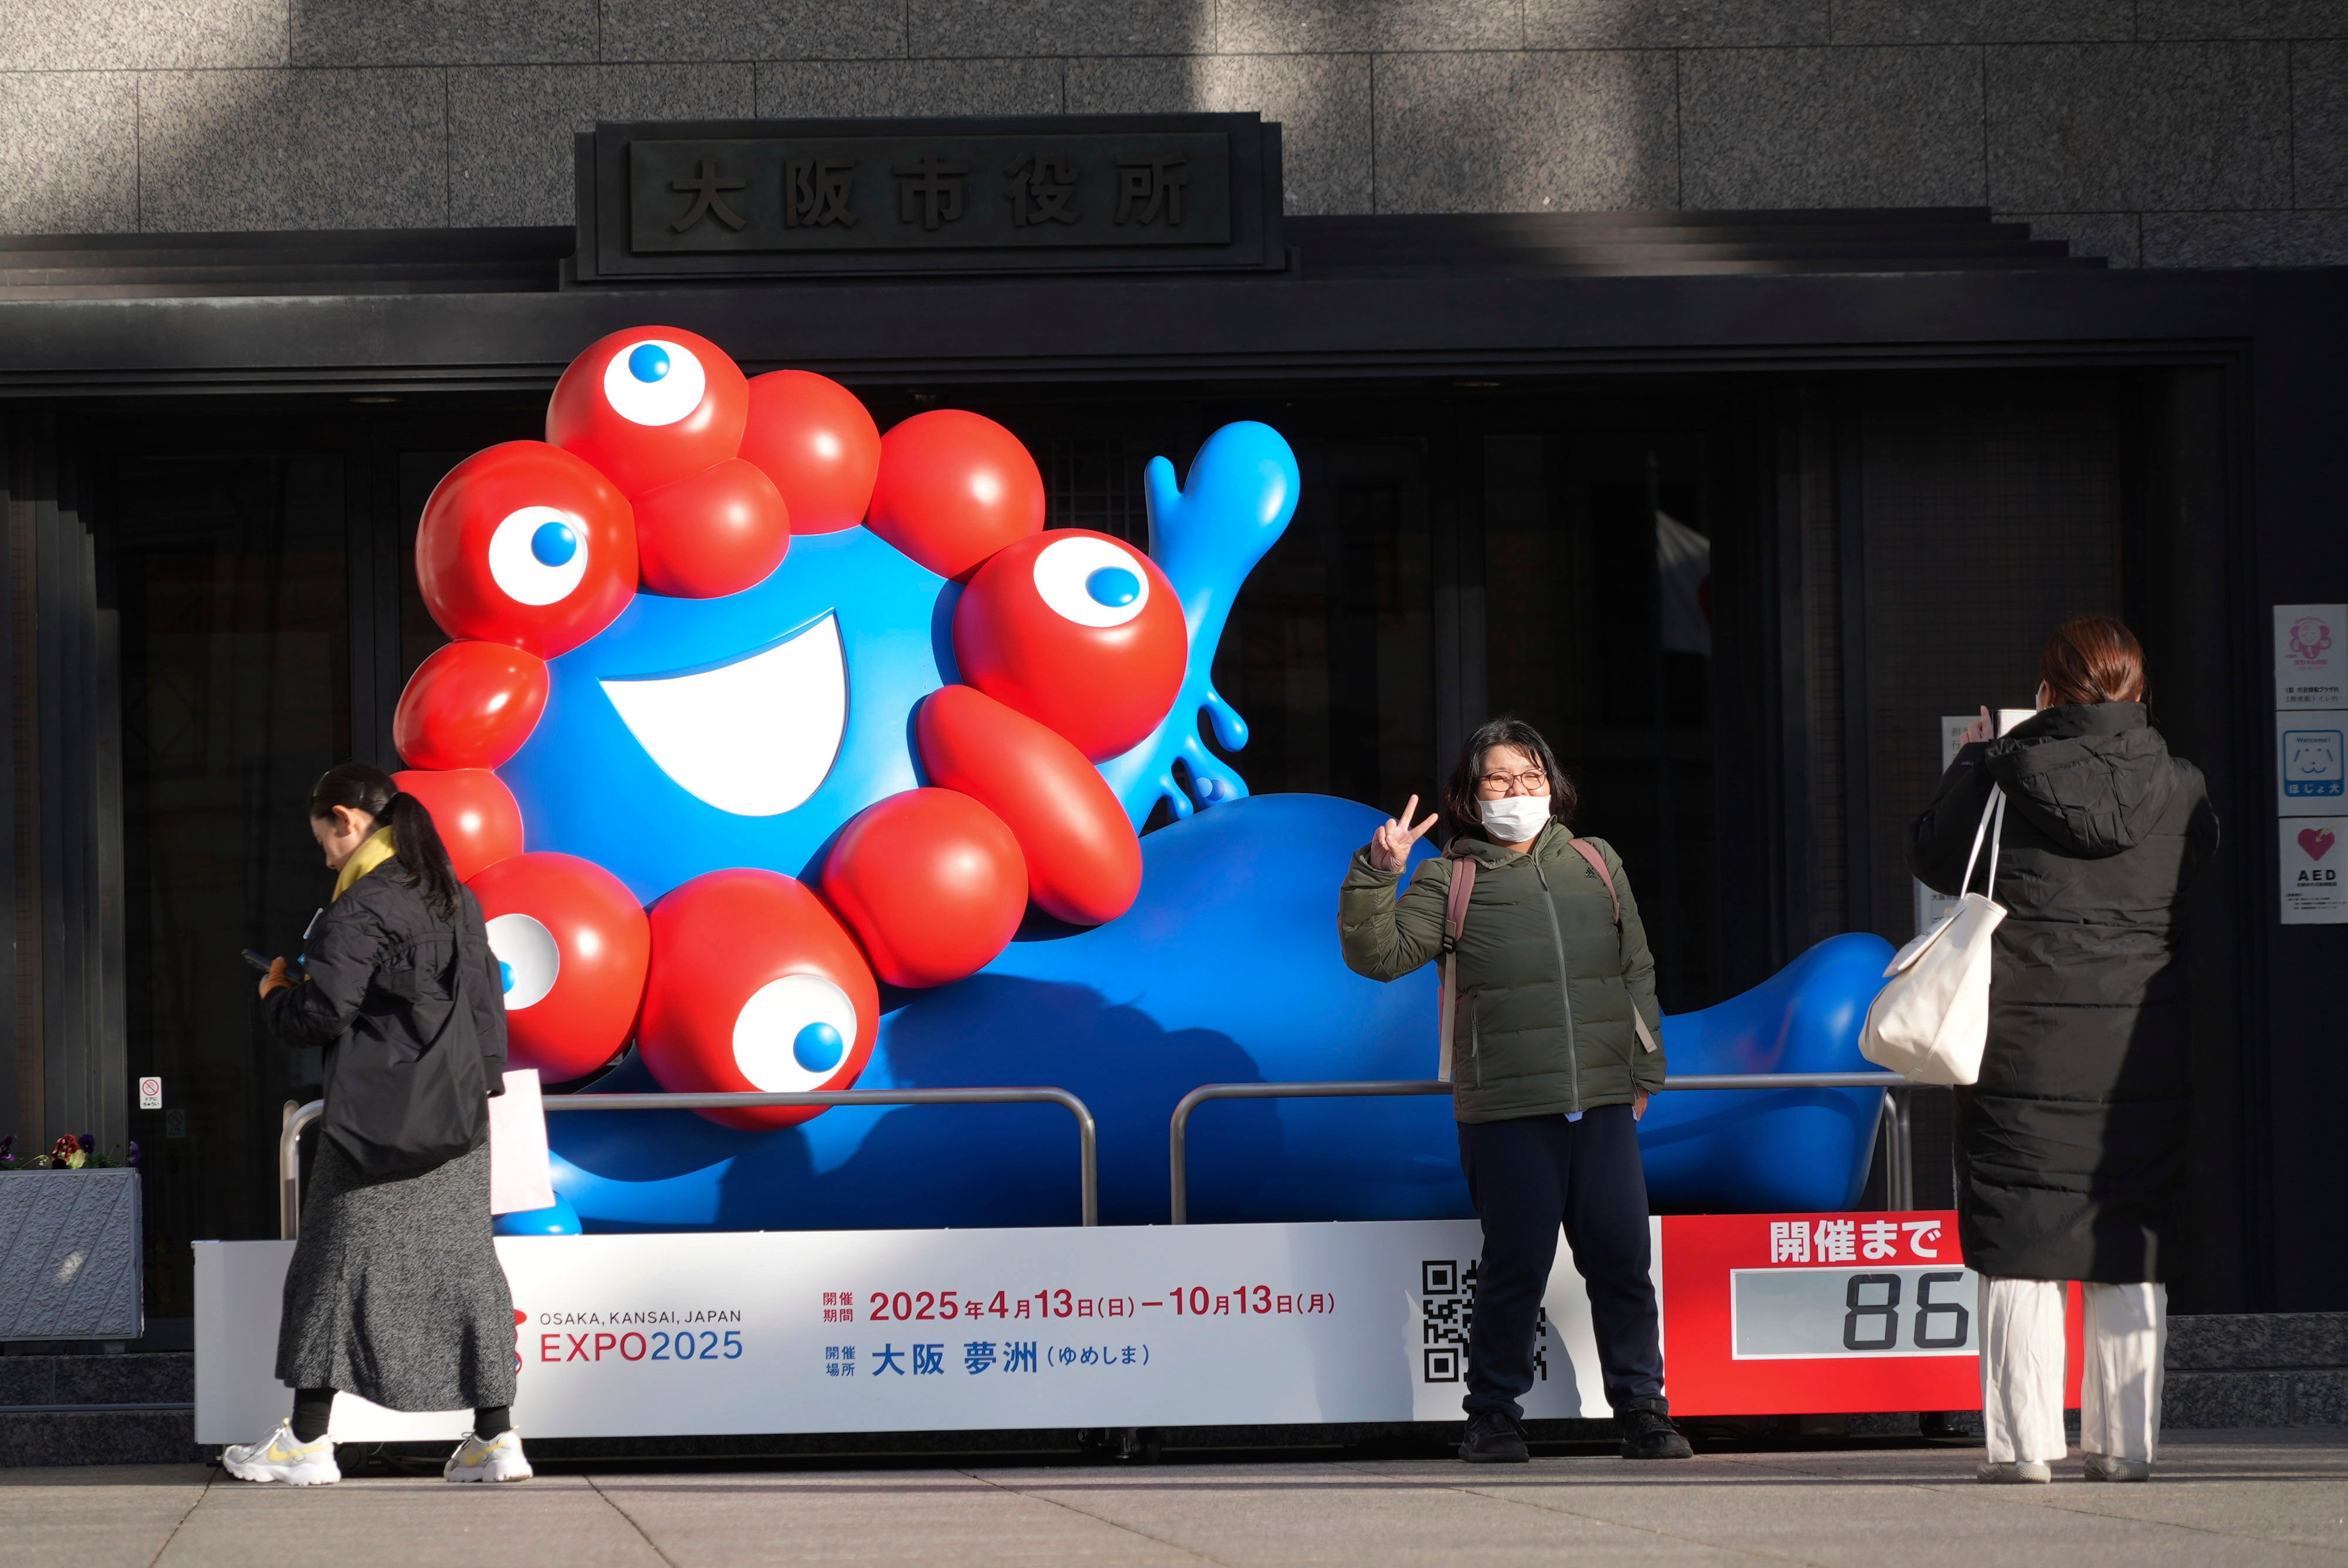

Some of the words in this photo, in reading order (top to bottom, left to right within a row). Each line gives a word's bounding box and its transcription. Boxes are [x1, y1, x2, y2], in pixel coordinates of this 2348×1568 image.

[669, 150, 1189, 233] 大阪市役所
[2289, 784, 2340, 794] ほじょ犬
[2298, 869, 2337, 881] AED
[1770, 1220, 1942, 1264] 開催まで
[823, 1291, 854, 1306] 開催
[540, 1312, 606, 1327] OSAKA,
[610, 1310, 681, 1326] KANSAI,
[684, 1310, 742, 1323] JAPAN
[823, 1309, 854, 1323] 期間
[1842, 1272, 1970, 1351] 86
[540, 1330, 743, 1363] EXPO2025
[825, 1345, 856, 1360] 開催
[872, 1343, 945, 1377] 大阪
[825, 1362, 855, 1377] 場所
